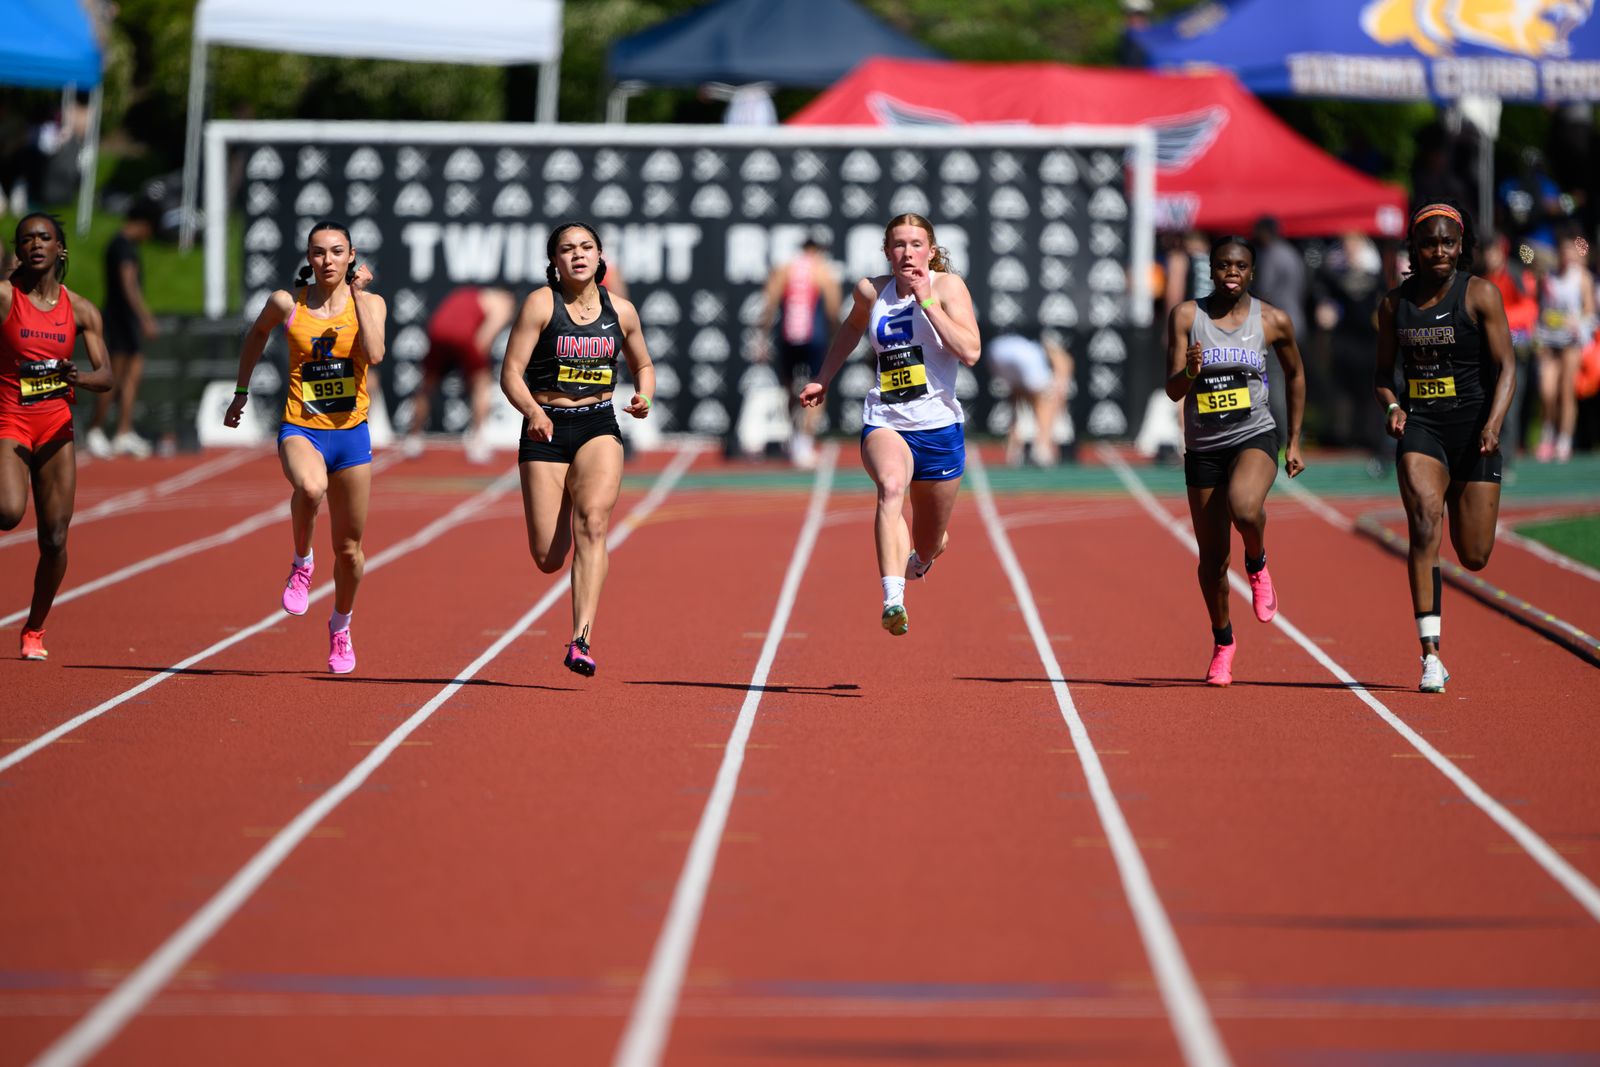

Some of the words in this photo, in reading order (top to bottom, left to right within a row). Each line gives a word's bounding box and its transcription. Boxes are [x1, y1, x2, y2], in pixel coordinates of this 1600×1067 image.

[20, 328, 66, 343] WESTVIEW
[557, 336, 614, 357] UNION
[886, 351, 911, 361] TWILIGHT
[312, 363, 342, 372] TWILIGHT
[891, 370, 912, 387] 512
[1204, 375, 1235, 384] TWILIGHT
[314, 381, 344, 397] 993
[1417, 381, 1447, 396] 1566
[1208, 393, 1238, 409] 525
